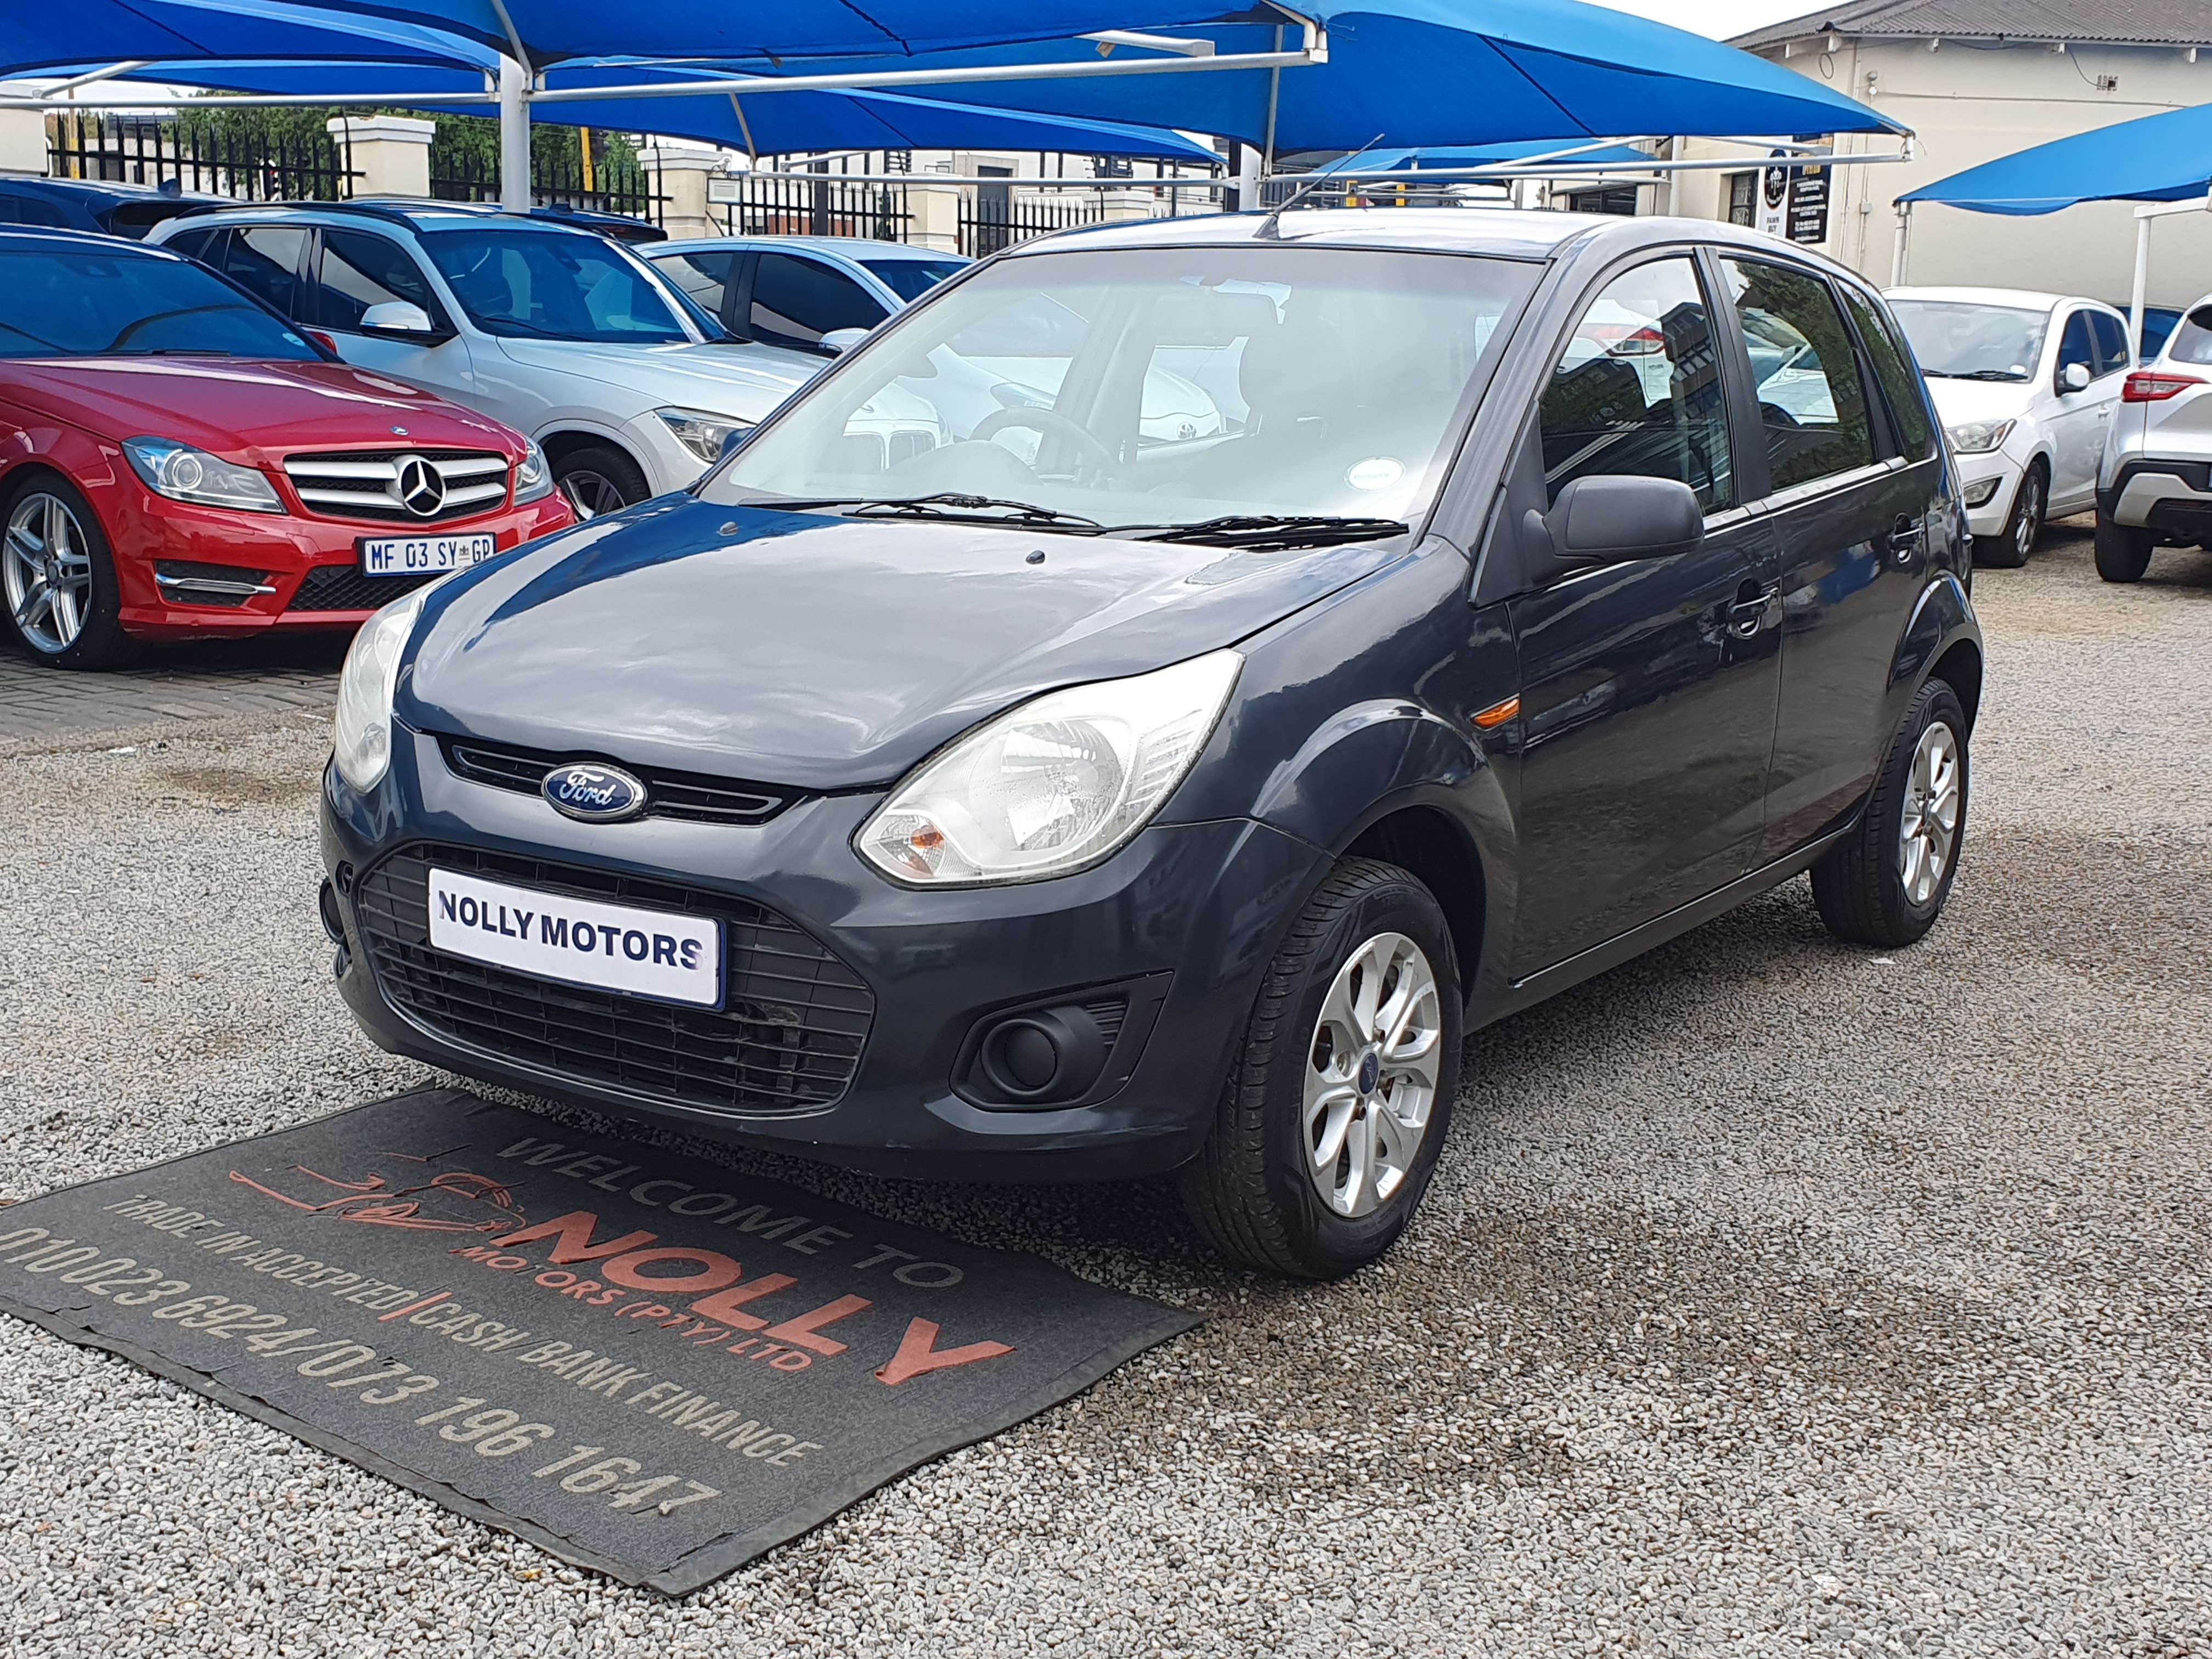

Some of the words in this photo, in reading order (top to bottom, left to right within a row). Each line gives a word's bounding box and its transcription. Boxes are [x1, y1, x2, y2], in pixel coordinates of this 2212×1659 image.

[371, 544, 395, 569] MF
[405, 543, 428, 568] 03
[438, 540, 458, 566] SY
[472, 538, 490, 563] GP
[558, 770, 617, 806] Ford
[438, 890, 534, 940] NOLLY
[541, 914, 703, 970] MOTORS
[496, 1137, 854, 1255] WELCOME
[853, 1244, 964, 1288] TO
[103, 1194, 225, 1238] TRADE
[195, 1231, 262, 1254] IN
[624, 1380, 825, 1468] FINANCE
[489, 1210, 1016, 1386] NOLLY
[614, 1301, 731, 1346] (PTY)
[726, 1338, 812, 1371] LTD
[414, 1396, 555, 1457] 196
[531, 1444, 723, 1516] 1647
